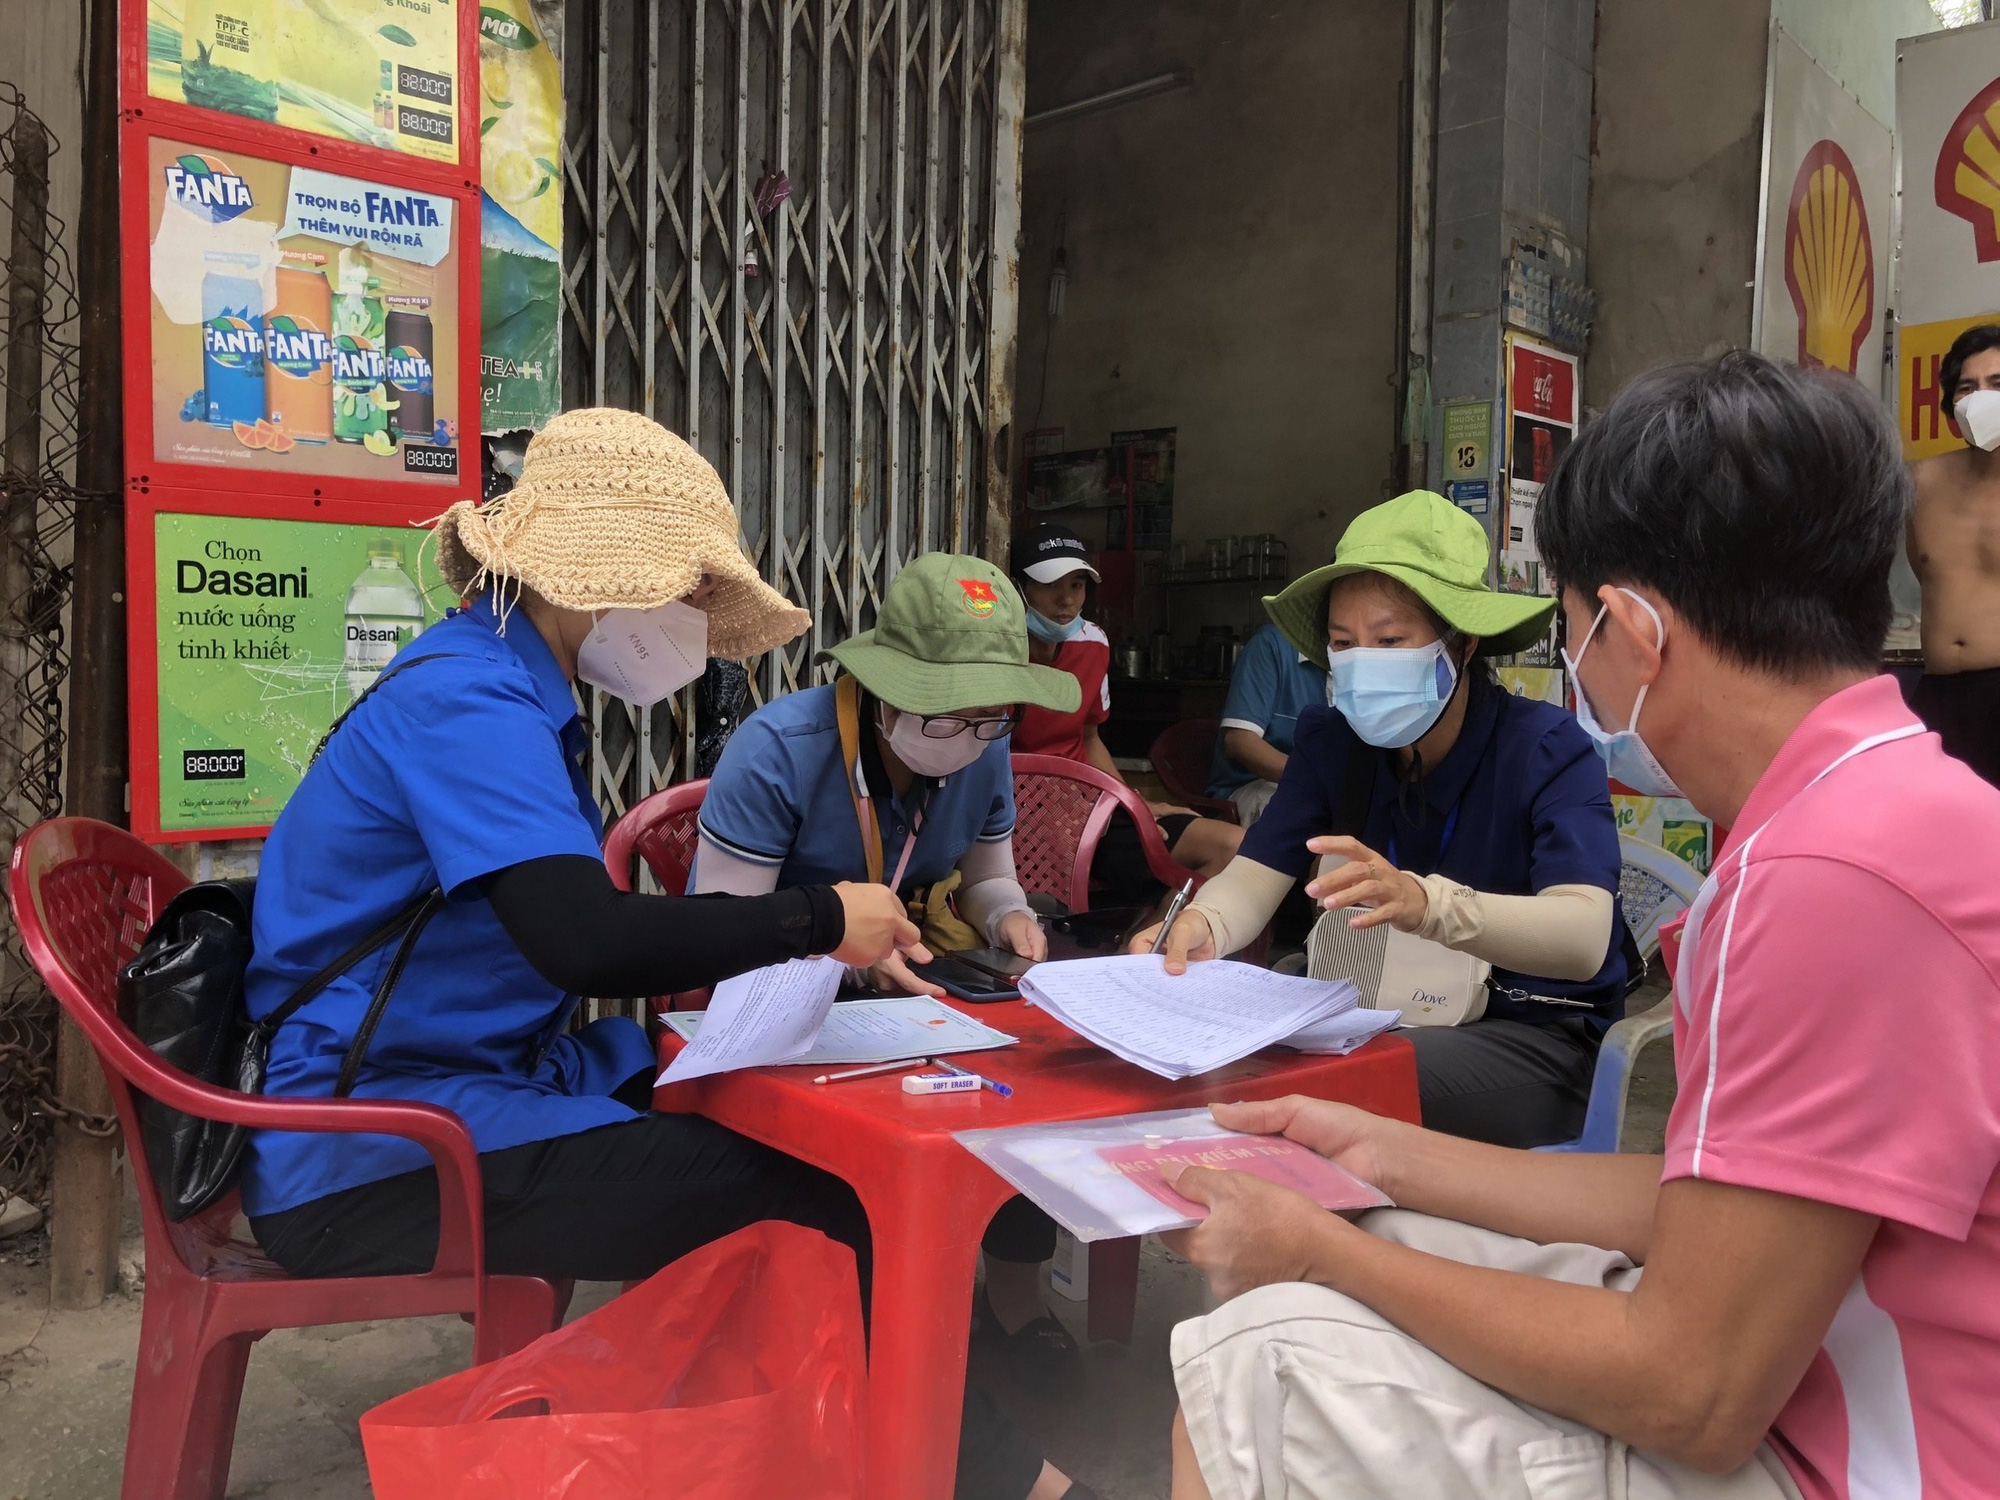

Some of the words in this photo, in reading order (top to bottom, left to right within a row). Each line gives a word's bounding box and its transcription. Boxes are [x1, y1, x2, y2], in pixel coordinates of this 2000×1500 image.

[166, 168, 252, 206] FANTA
[295, 193, 338, 212] TRỌN
[340, 199, 361, 217] BỘ
[365, 192, 439, 227] FANTA
[298, 218, 340, 234] THÊM
[343, 225, 368, 239] VUI
[371, 228, 401, 246] RỘN
[404, 233, 423, 247] RÃ
[204, 327, 264, 353] FANTA
[264, 329, 332, 360] FANTA
[333, 349, 386, 377] FANTA
[387, 357, 432, 377] FANTA
[480, 383, 502, 407] ẹ!
[1457, 446, 1475, 468] 18
[205, 540, 262, 564] Chọn
[177, 560, 307, 598] Dasani
[178, 604, 234, 626] nước
[240, 603, 296, 633] uống
[347, 626, 400, 642] Dasani
[628, 632, 650, 660] KN95
[178, 639, 227, 659] tinh
[233, 635, 292, 660] khiết
[1412, 987, 1446, 1006] Dove
[933, 1082, 948, 1090] SOFT
[951, 1080, 974, 1089] ERASER
